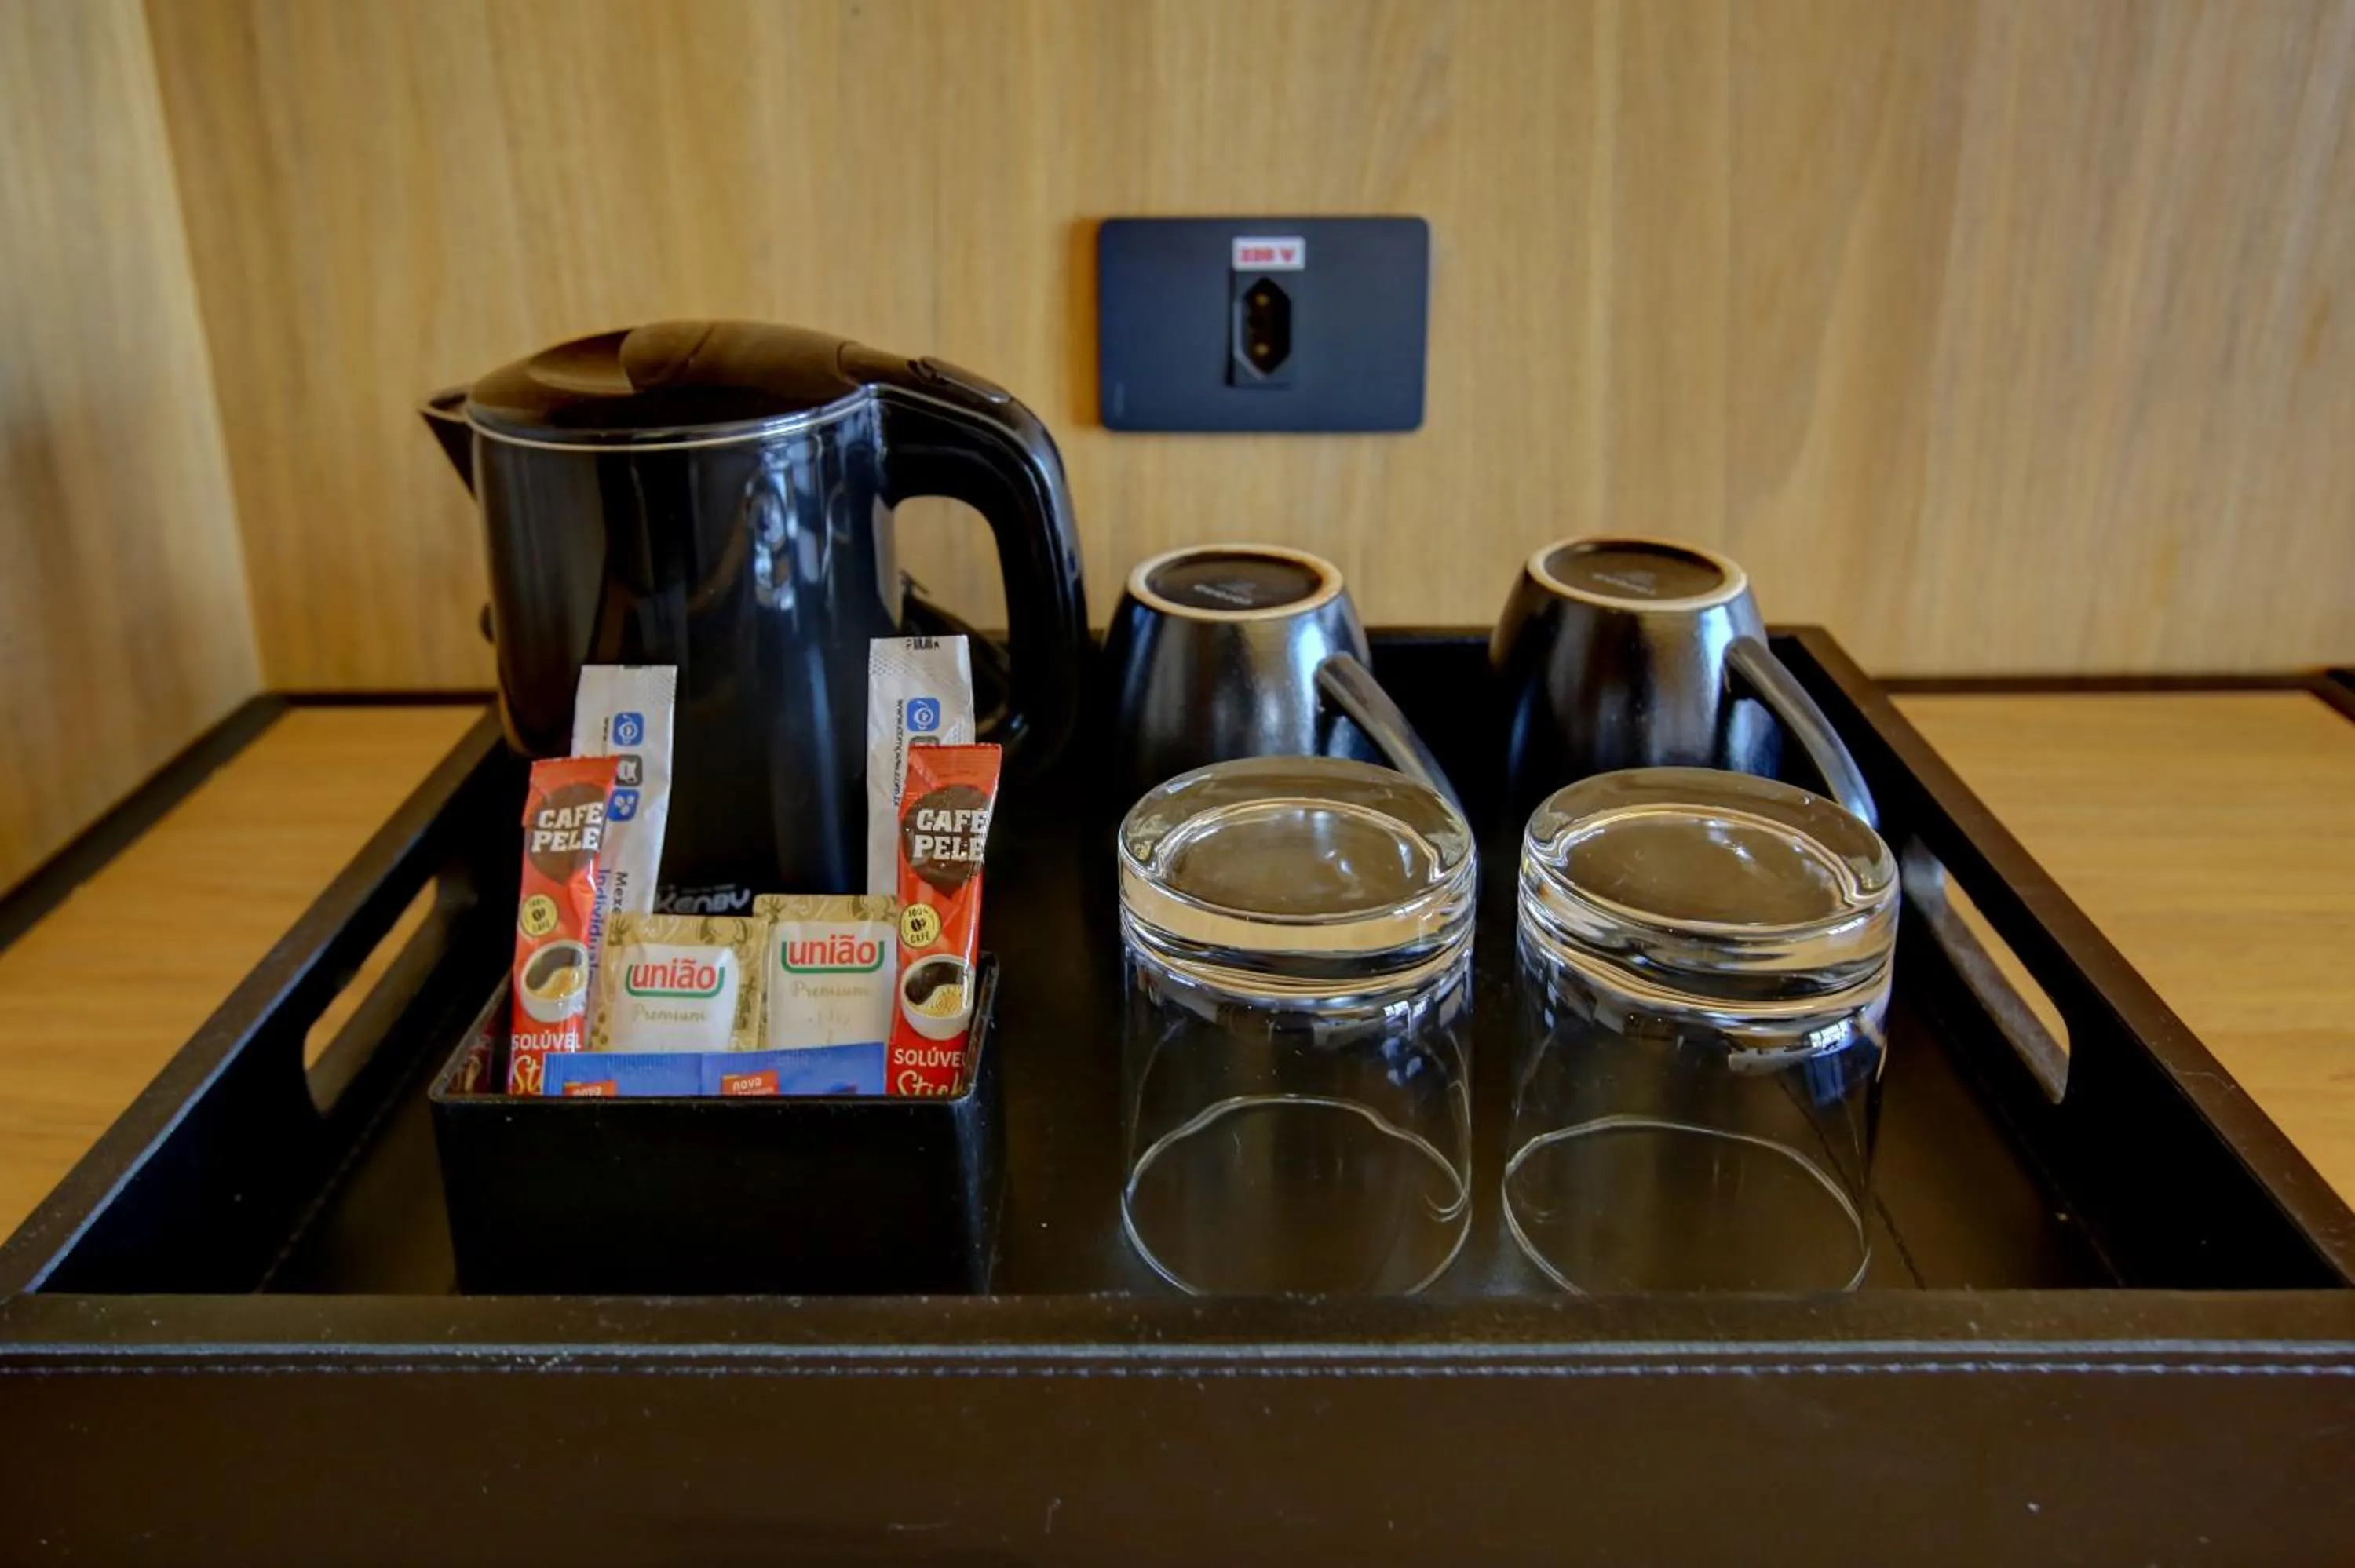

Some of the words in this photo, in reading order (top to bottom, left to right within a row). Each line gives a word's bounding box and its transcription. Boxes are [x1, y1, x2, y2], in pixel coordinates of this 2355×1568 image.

[611, 871, 629, 915] Mexe
[789, 935, 876, 965] união
[633, 957, 716, 989] união
